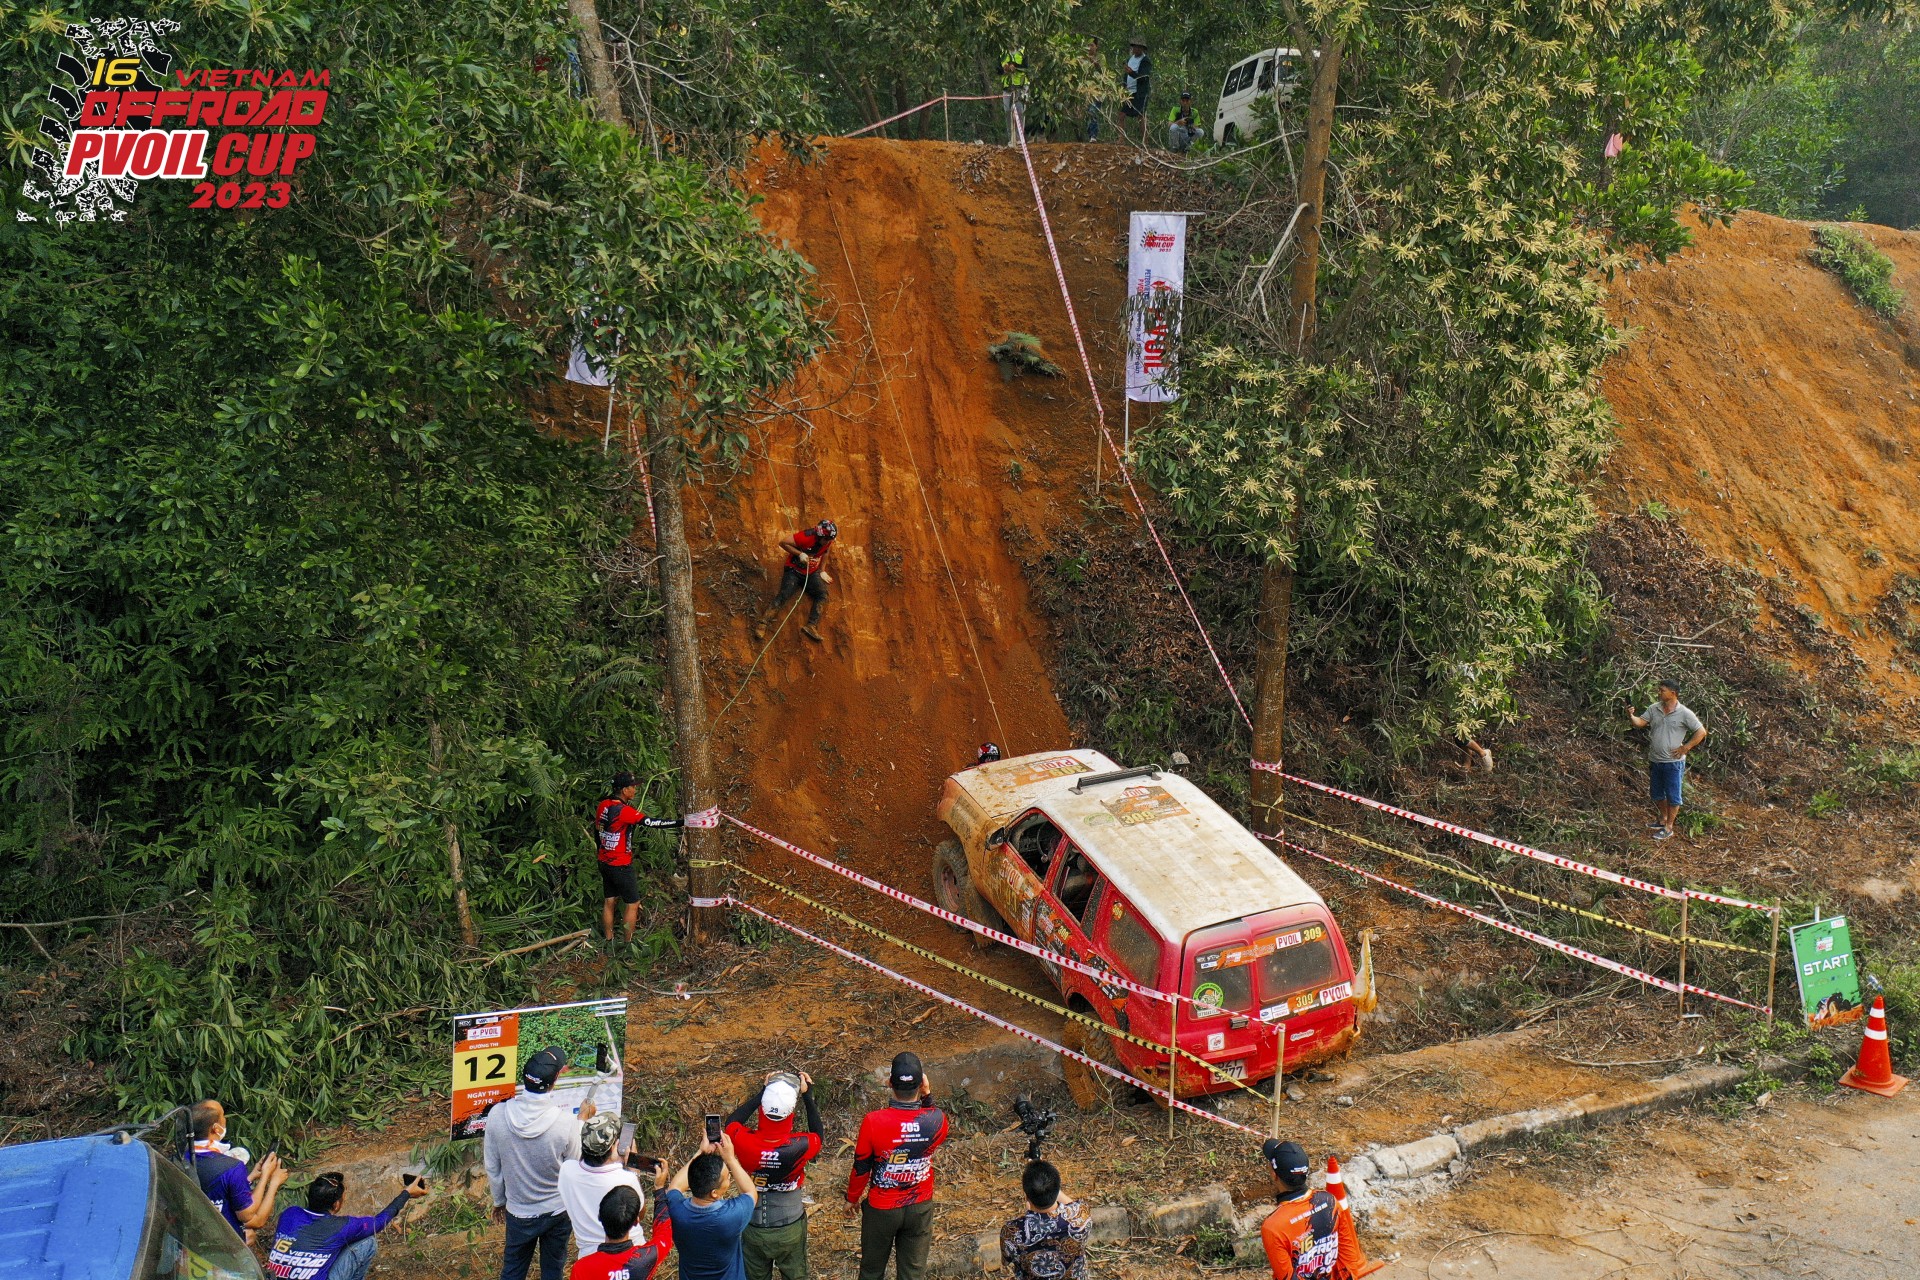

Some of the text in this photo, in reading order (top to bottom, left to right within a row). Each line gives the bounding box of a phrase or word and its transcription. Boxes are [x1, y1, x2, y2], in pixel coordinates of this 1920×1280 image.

[1121, 811, 1155, 824] 309
[1278, 926, 1322, 948] PVOIL 309
[1803, 953, 1850, 976] START
[1296, 993, 1314, 1008] 309
[1322, 985, 1350, 1005] PVOIL
[480, 1028, 499, 1036] PVOIL
[464, 1053, 506, 1082] 12
[473, 1098, 493, 1106] 27/10
[900, 1122, 920, 1133] 205
[760, 1150, 780, 1161] 222
[888, 1153, 909, 1164] 16
[1300, 1234, 1314, 1255] 16
[268, 1250, 330, 1268] OFFROAD
[288, 1249, 332, 1259] VIETNAM
[289, 1267, 320, 1280] CUP
[608, 1269, 630, 1280] 205
